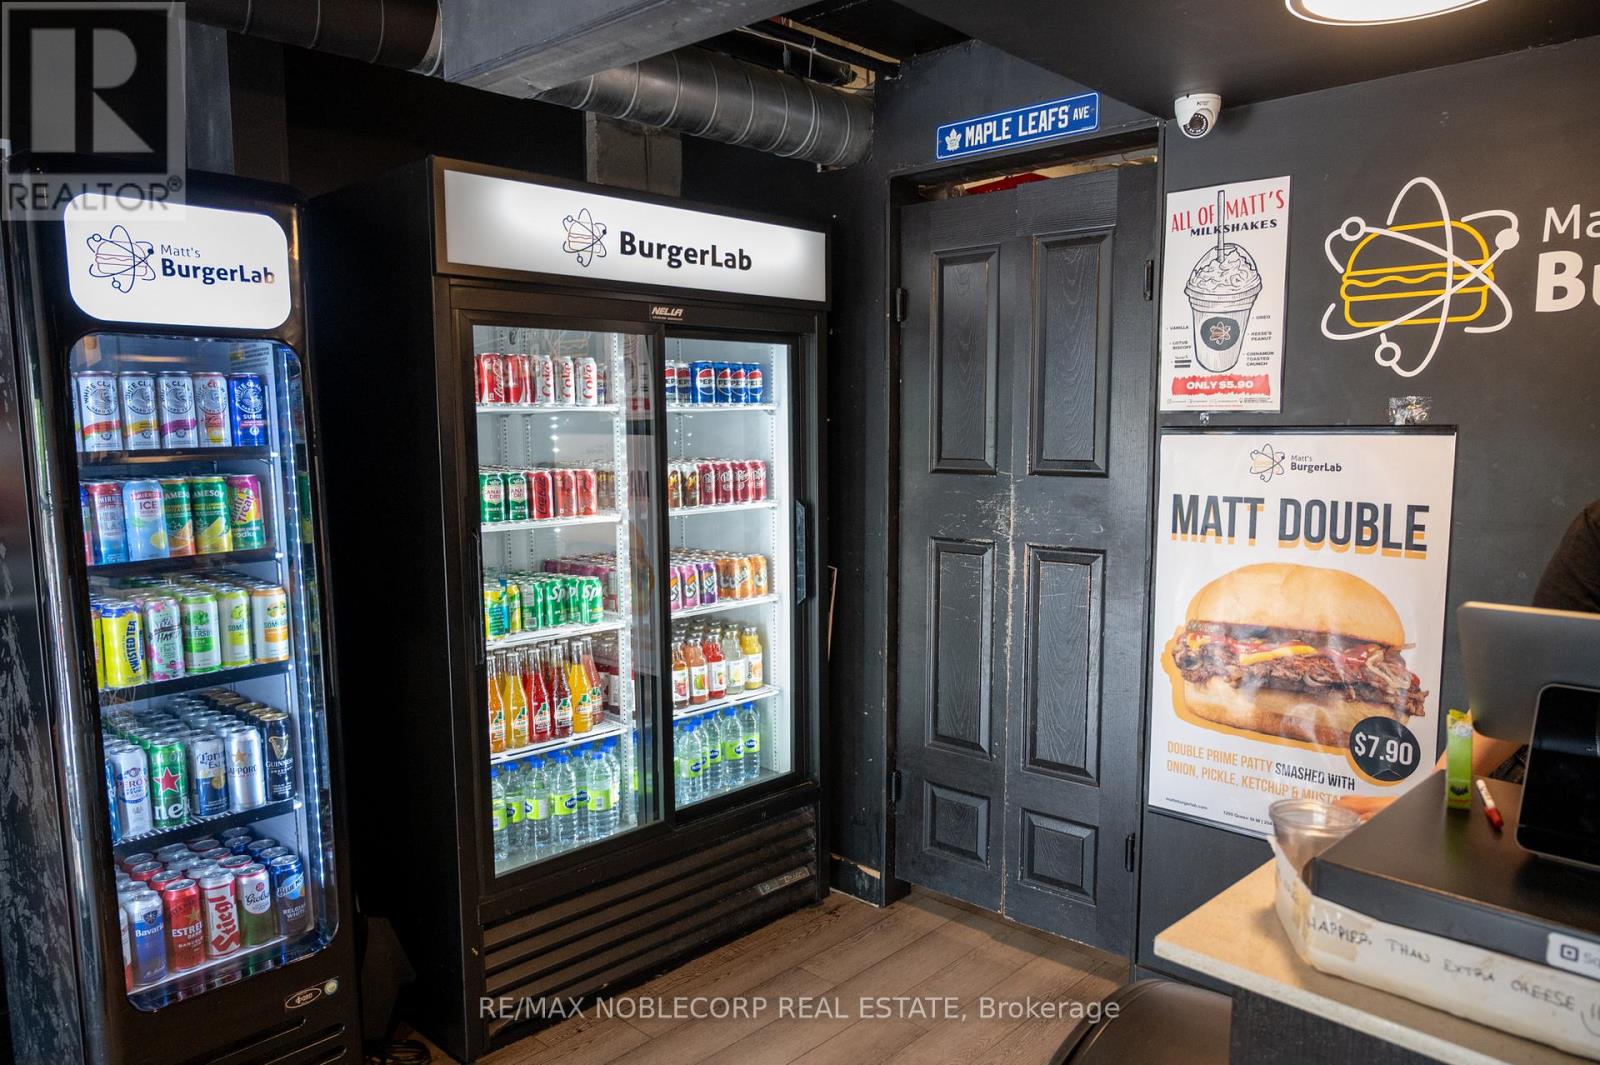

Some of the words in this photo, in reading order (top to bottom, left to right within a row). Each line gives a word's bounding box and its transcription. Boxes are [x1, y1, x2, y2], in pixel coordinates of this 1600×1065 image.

[965, 117, 1012, 147] MAPLE
[1018, 105, 1069, 137] LEAFS
[1073, 105, 1090, 121] AVE
[1171, 210, 1193, 232] ALL
[1198, 204, 1214, 226] OF
[1226, 189, 1285, 220] MATT'S
[1190, 219, 1278, 237] MILKSHAKES
[160, 244, 201, 258] Matt's
[619, 230, 753, 270] BurgerLab
[161, 258, 275, 285] BurgerLab
[1535, 250, 1600, 313] B
[651, 306, 684, 317] NELLA
[541, 360, 553, 397] Coke
[561, 361, 573, 398] Coke
[583, 364, 594, 399] Coke
[1186, 380, 1217, 390] ONLY
[1290, 461, 1342, 474] BurgerLab
[1291, 454, 1313, 463] Matt's
[139, 500, 158, 510] ICE
[1171, 493, 1265, 547] MATT
[1278, 497, 1430, 560] DOUBLE
[126, 620, 138, 637] TEA
[126, 637, 141, 674] TWISTED
[265, 757, 294, 769] GUINNESS
[1167, 740, 1205, 760] DOUBLE
[1206, 748, 1238, 767] PRIME
[1240, 755, 1273, 773] PATTY
[1275, 762, 1325, 785] SMASHED
[1328, 772, 1355, 791] WITH
[1354, 731, 1413, 766] $7.90
[1241, 775, 1289, 797] KETCHUP
[276, 883, 295, 897] BLUE
[207, 895, 241, 952] Stiegl
[1384, 938, 1431, 964] THAN
[1443, 958, 1495, 983] EXTRA
[1510, 979, 1575, 1011] CHEESE
